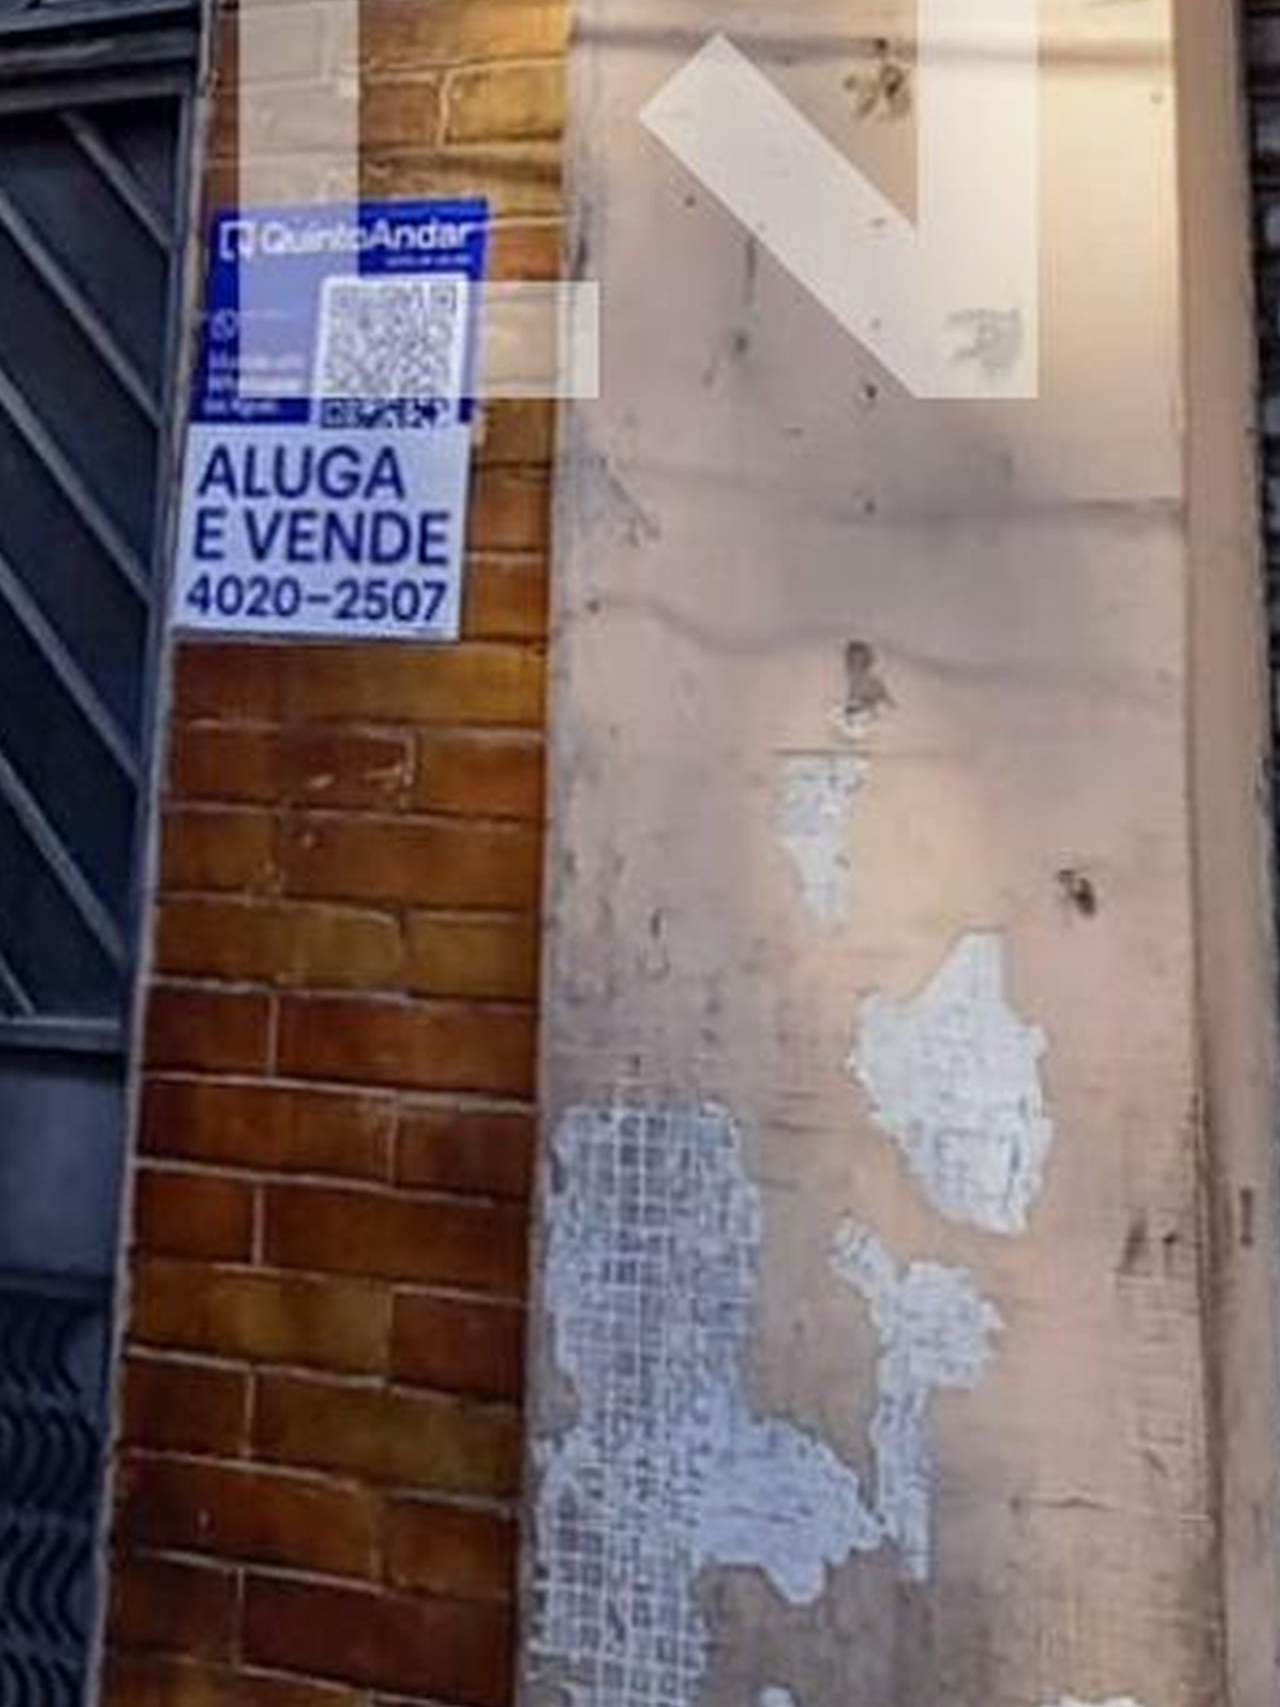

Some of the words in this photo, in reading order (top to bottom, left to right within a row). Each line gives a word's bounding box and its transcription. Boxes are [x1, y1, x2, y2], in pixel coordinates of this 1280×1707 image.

[261, 216, 478, 254] QuintoAndar
[197, 444, 405, 500] ALUGA
[194, 506, 227, 561] E
[243, 508, 450, 565] VENDE
[186, 573, 448, 622] 4020-2507
